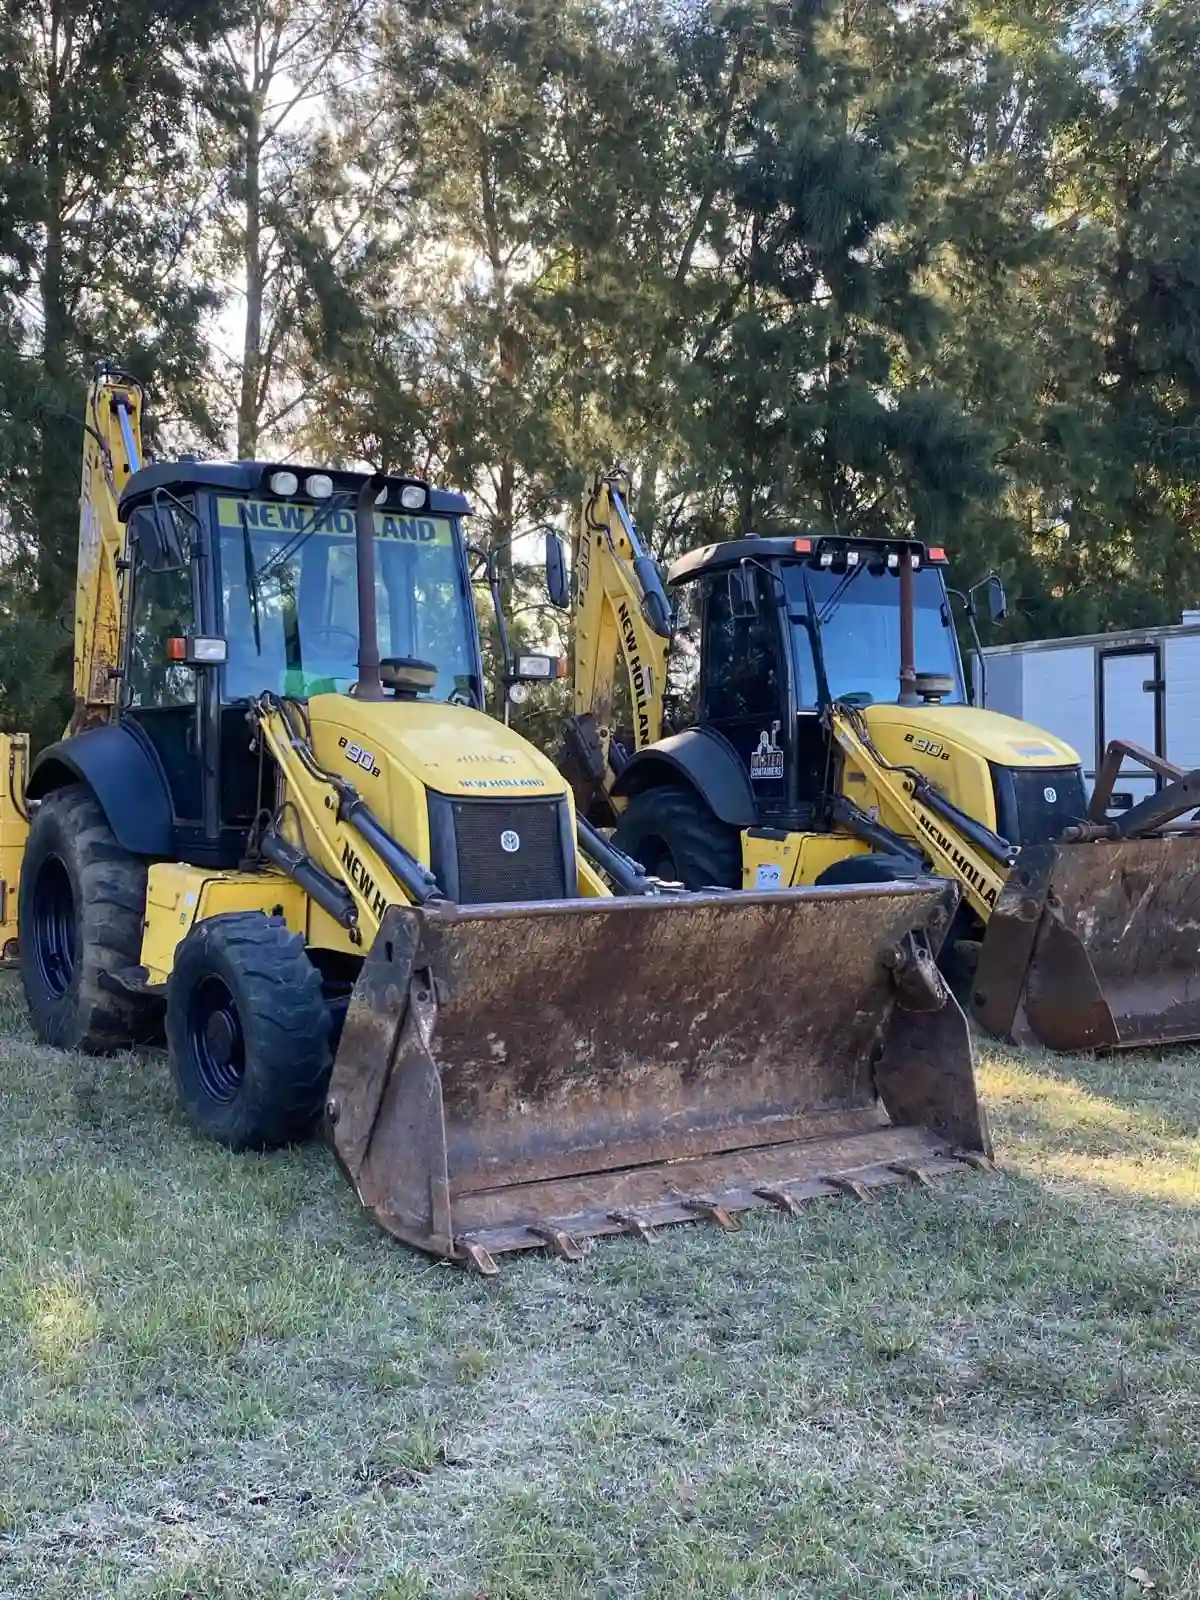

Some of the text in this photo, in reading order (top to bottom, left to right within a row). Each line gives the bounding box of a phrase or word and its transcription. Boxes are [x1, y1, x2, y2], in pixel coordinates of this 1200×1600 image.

[236, 501, 436, 542] NEW HOAND
[618, 601, 638, 653] NEW
[338, 735, 381, 778] B90B
[903, 733, 950, 761] B90B
[458, 778, 545, 788] NEW HOLLAND
[919, 814, 953, 852] NEW
[341, 840, 375, 900] NEW
